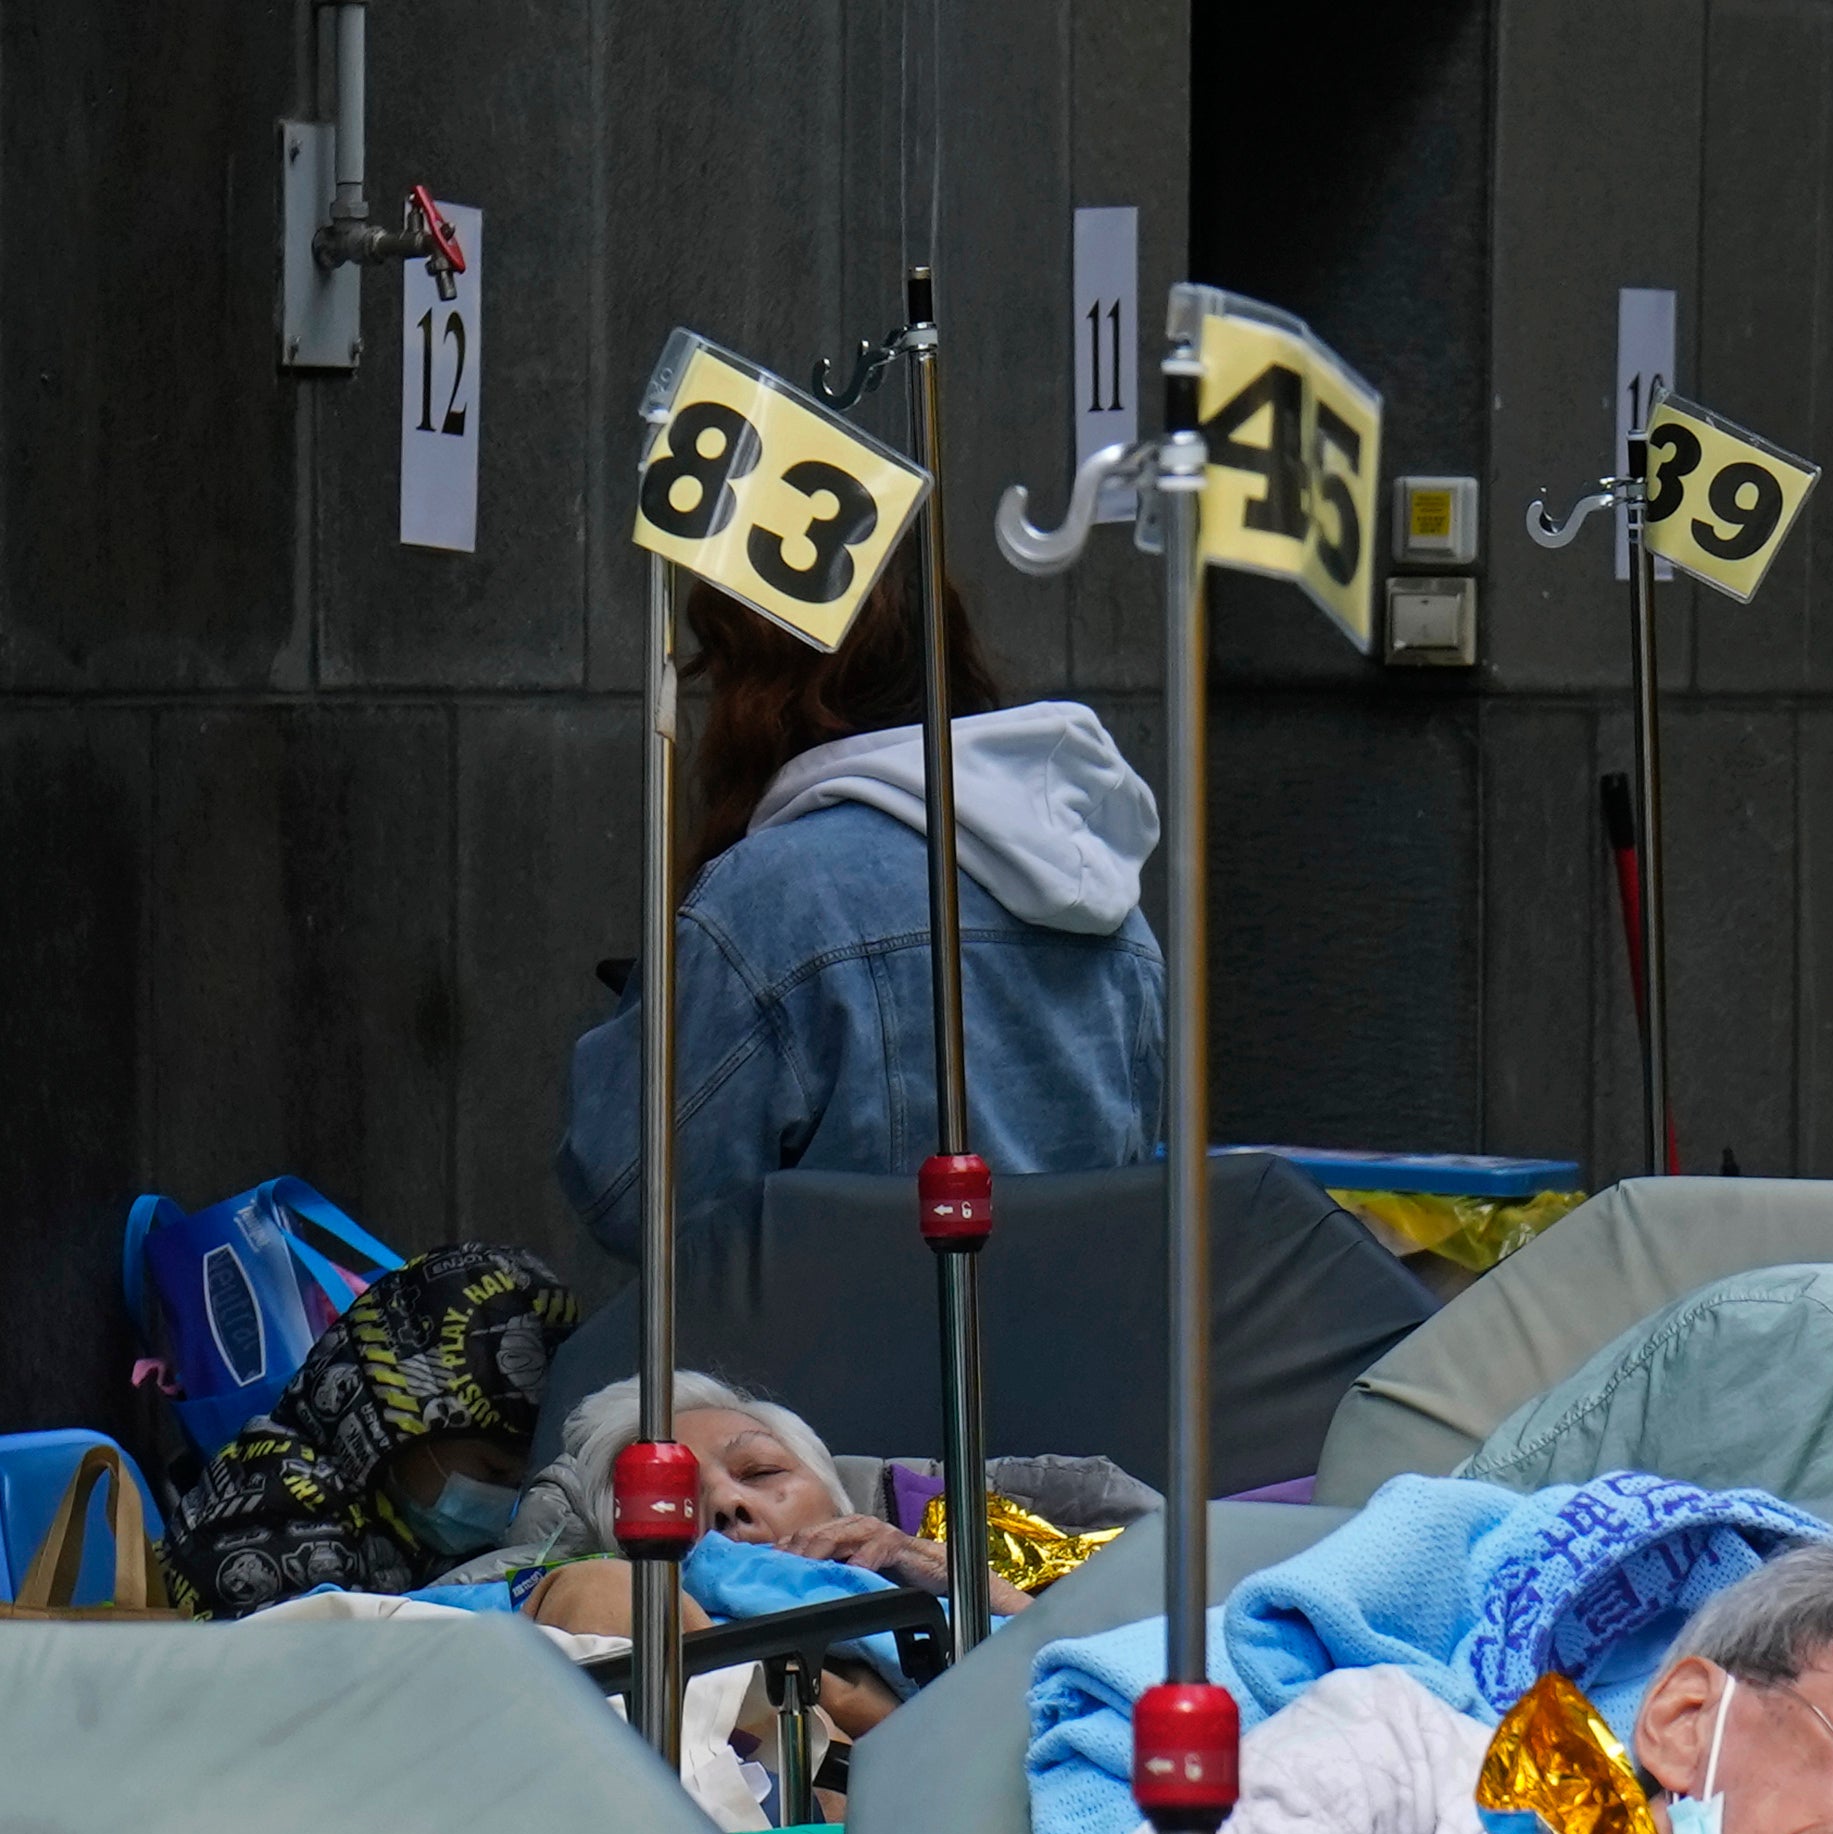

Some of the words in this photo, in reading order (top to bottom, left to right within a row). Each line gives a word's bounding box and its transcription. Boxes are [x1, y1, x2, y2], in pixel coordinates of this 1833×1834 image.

[415, 308, 468, 437] 12
[1085, 296, 1126, 416] 11
[640, 401, 879, 604] 83
[1199, 364, 1361, 587] 45
[1646, 423, 1784, 561] 39
[462, 1269, 516, 1306] HAV
